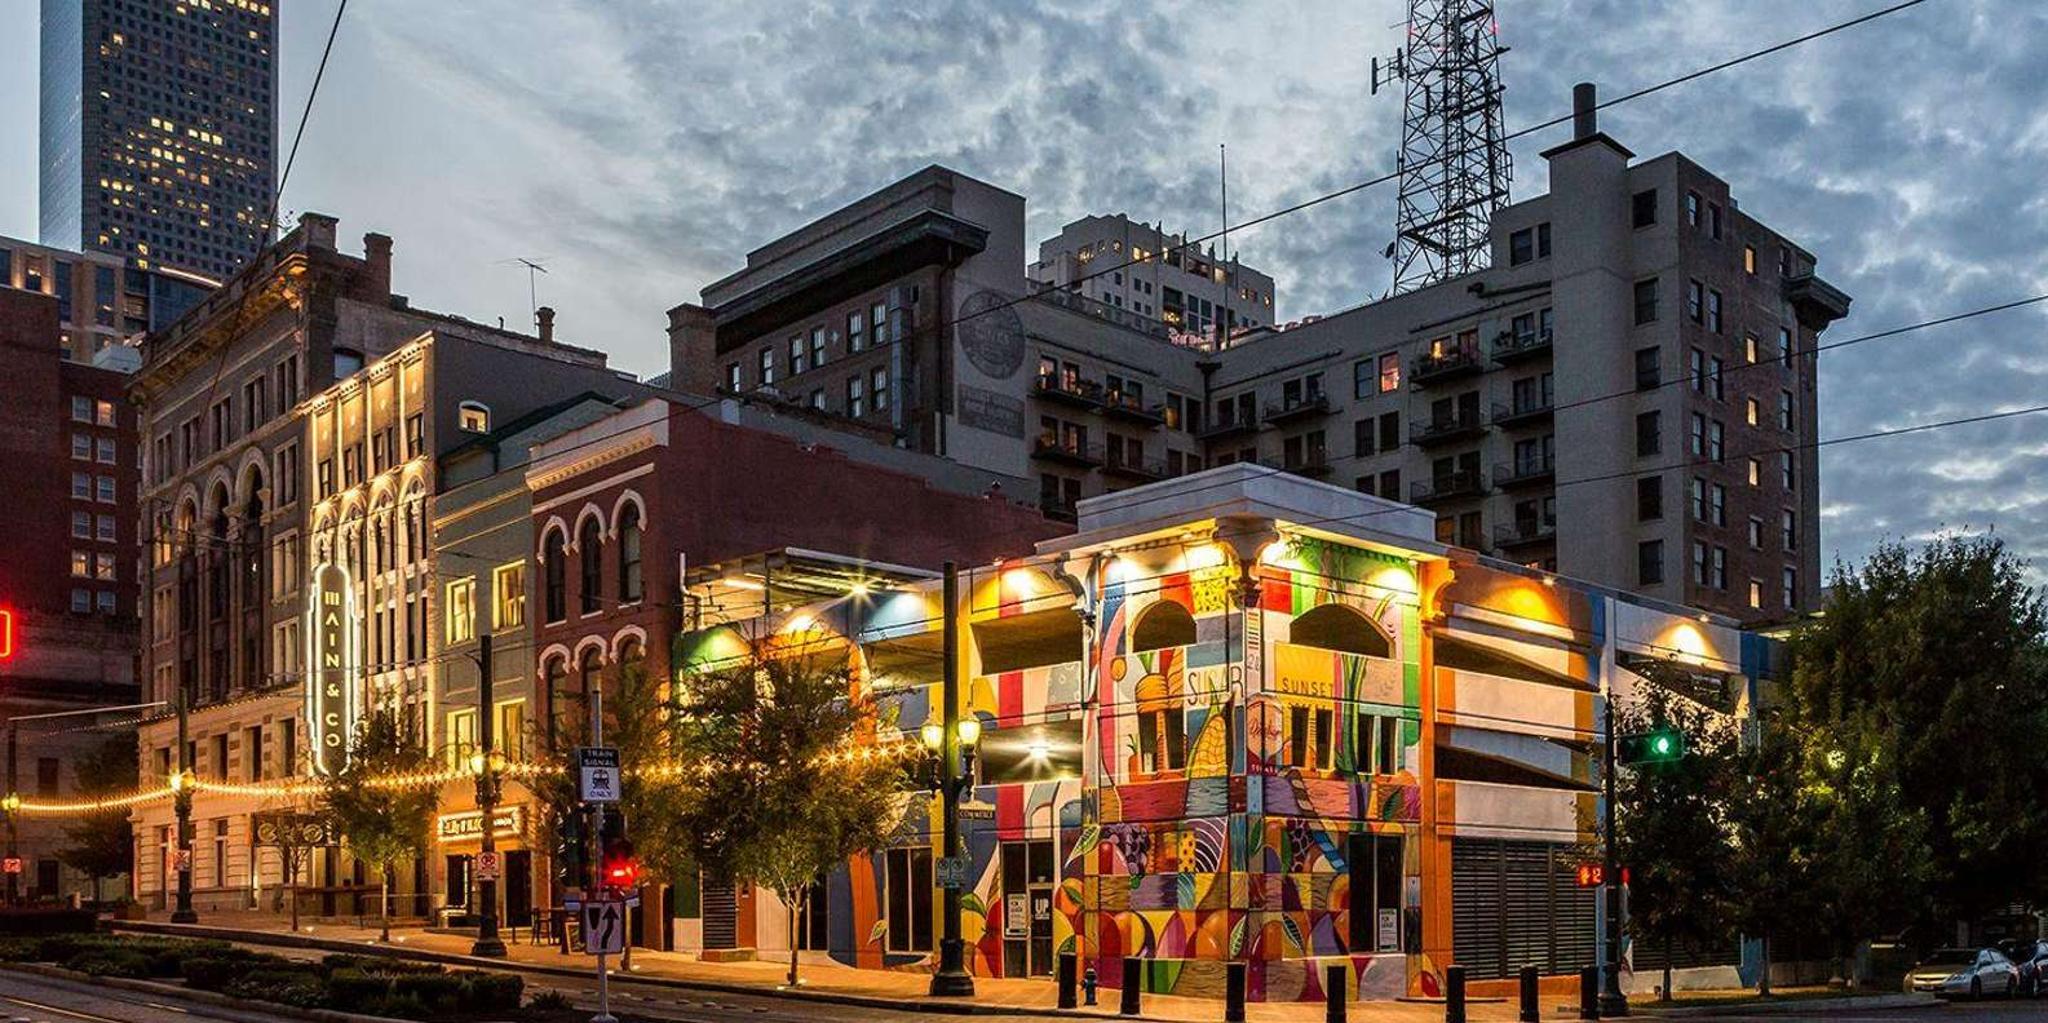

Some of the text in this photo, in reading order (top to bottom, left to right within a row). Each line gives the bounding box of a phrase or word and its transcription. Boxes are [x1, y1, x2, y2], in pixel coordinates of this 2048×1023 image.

[325, 591, 341, 747] MAIN & CO
[1282, 677, 1333, 698] SUNSET
